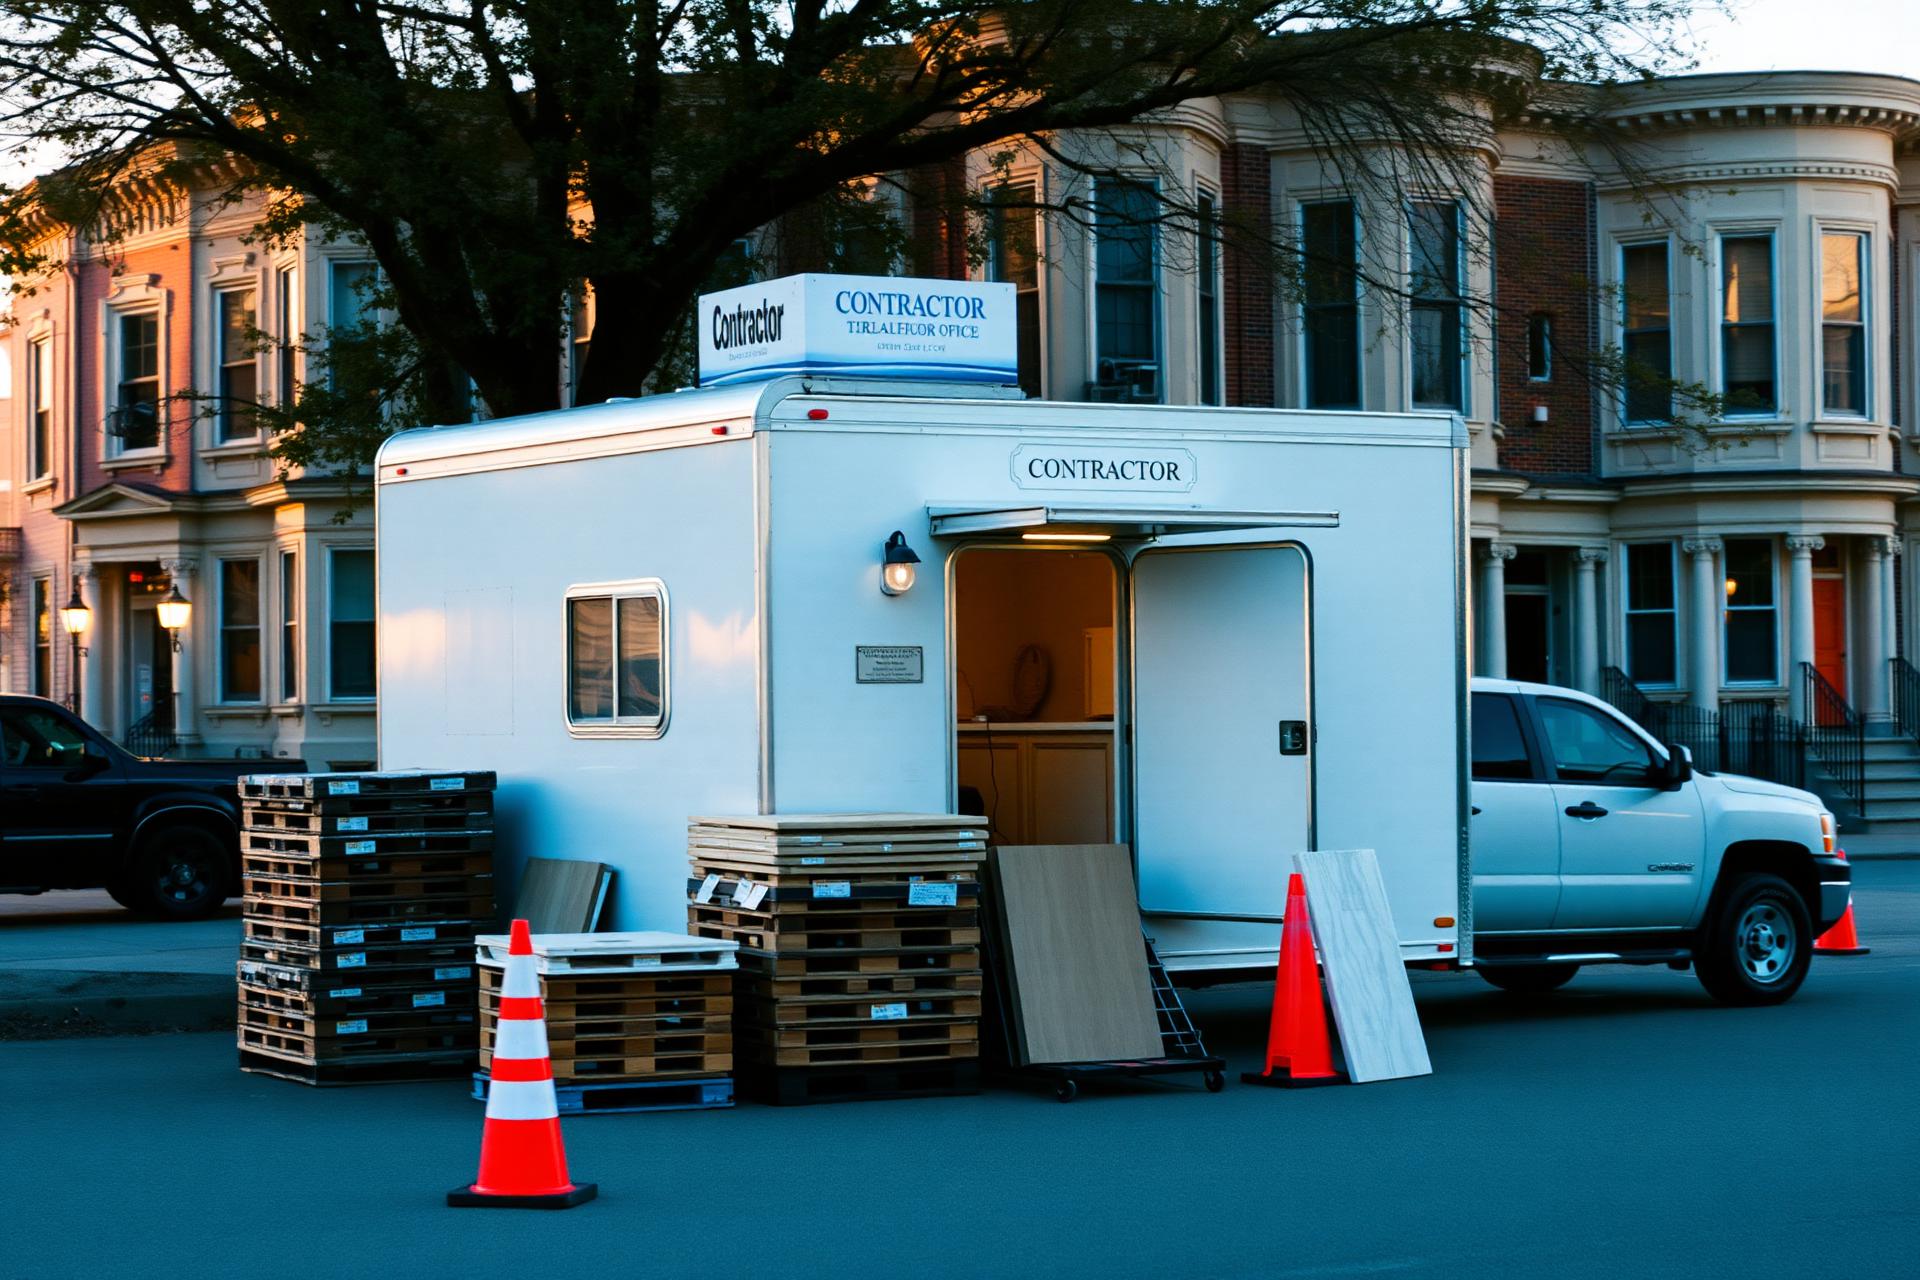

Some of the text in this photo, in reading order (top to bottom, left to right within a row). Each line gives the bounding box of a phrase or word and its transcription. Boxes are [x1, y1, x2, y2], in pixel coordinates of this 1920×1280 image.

[835, 290, 987, 320] CONTRACTOR
[712, 298, 784, 350] Contractor
[1028, 458, 1181, 482] CONTRACTOR
